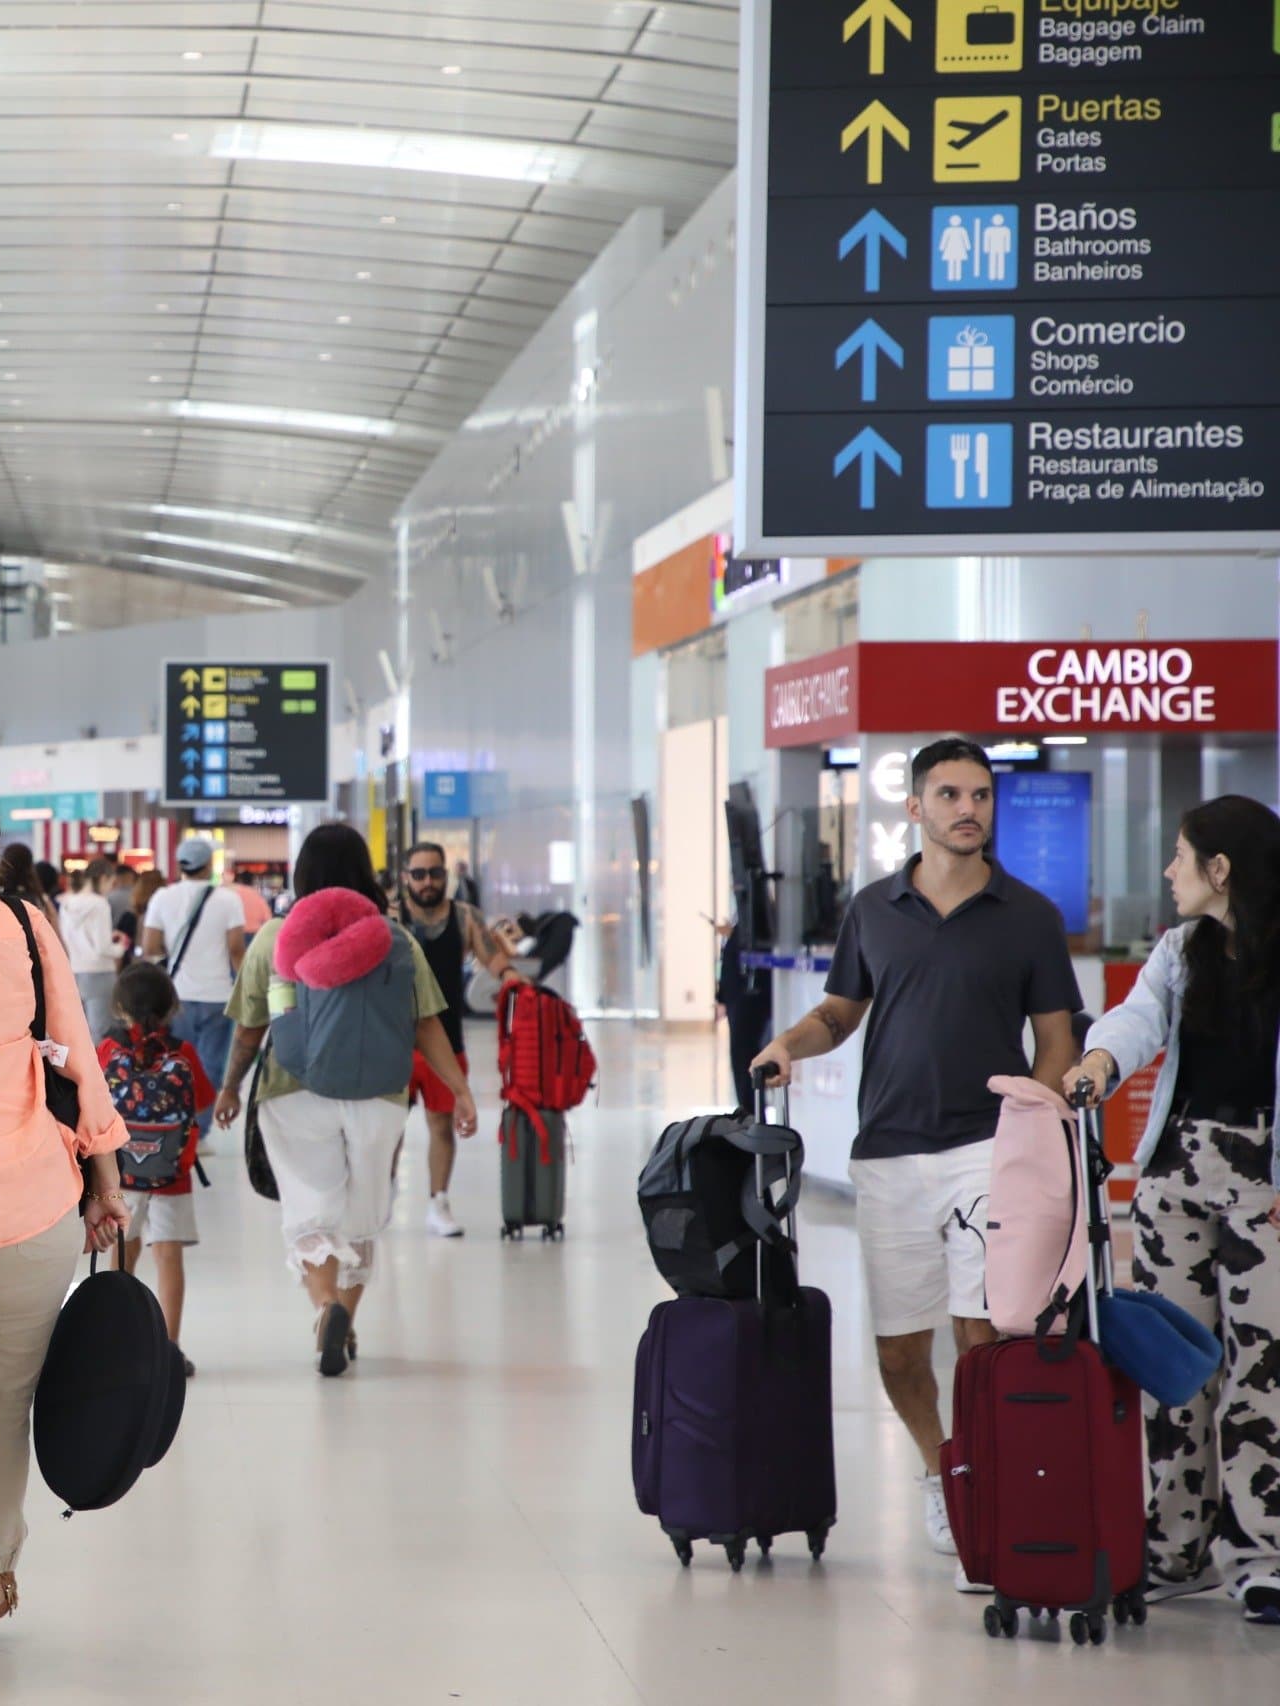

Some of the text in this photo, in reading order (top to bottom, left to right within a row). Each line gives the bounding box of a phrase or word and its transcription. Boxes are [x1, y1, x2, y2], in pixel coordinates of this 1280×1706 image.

[1039, 14, 1205, 41] Baggage Claim
[1039, 43, 1142, 66] Bagagem
[1038, 94, 1161, 122] Puertas
[1037, 127, 1102, 148] Gates
[1037, 153, 1106, 173] Portas
[1035, 202, 1137, 231] Baños
[1034, 236, 1151, 256] Bathrooms
[1034, 260, 1143, 281] Banheiros
[1031, 315, 1185, 346] Comercio
[1031, 350, 1099, 374] Shops
[1030, 374, 1133, 395] Comércio
[1029, 421, 1243, 450] Restaurantes
[1029, 455, 1158, 474] Restaurants
[1028, 477, 1264, 504] Praça de Alimentação
[1028, 648, 1192, 685] CAMBIO
[997, 686, 1215, 722] EXCHANGE
